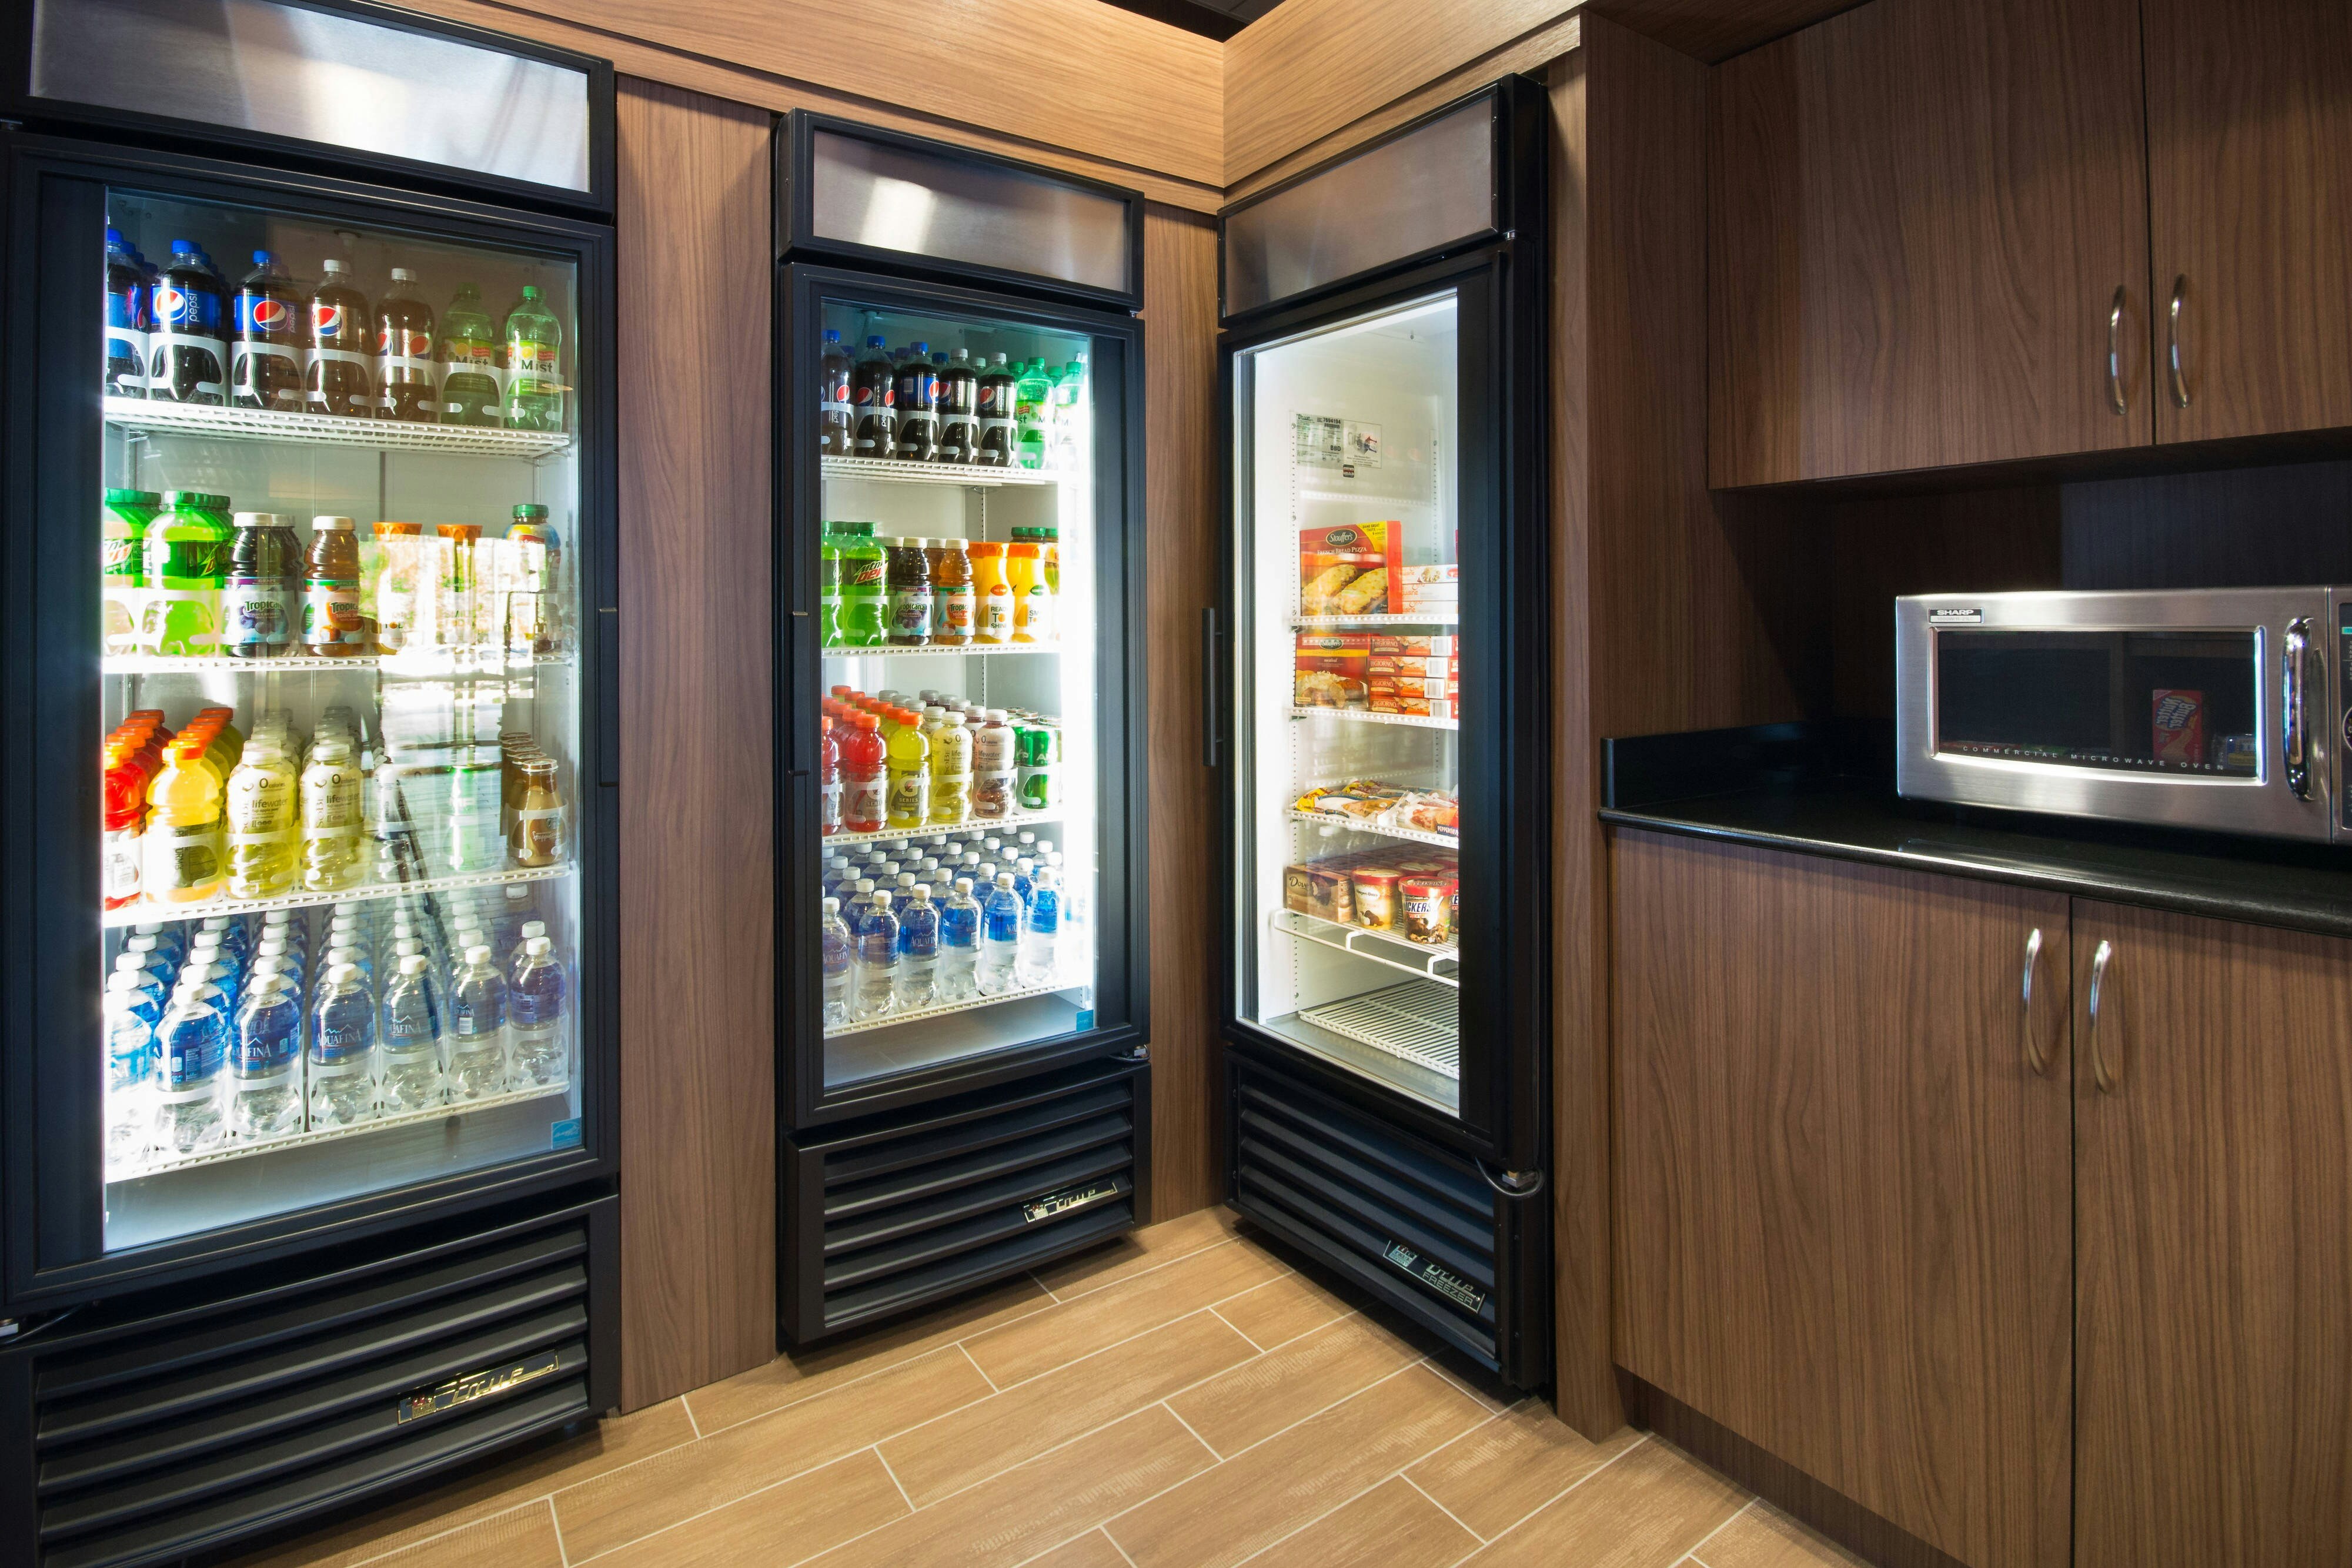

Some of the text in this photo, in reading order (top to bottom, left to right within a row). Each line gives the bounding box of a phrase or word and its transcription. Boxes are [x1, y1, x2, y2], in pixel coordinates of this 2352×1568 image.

[189, 293, 200, 322] pepsi
[521, 360, 553, 373] Mist
[1329, 531, 1354, 543] Stouffer's
[1963, 745, 2224, 770] COMMERCIAL MICROWAVE OVEN
[252, 798, 288, 808] lifewater
[326, 793, 359, 804] lifewater
[317, 1029, 361, 1047] AQUAFINA
[1422, 1271, 1474, 1307] FREEZER
